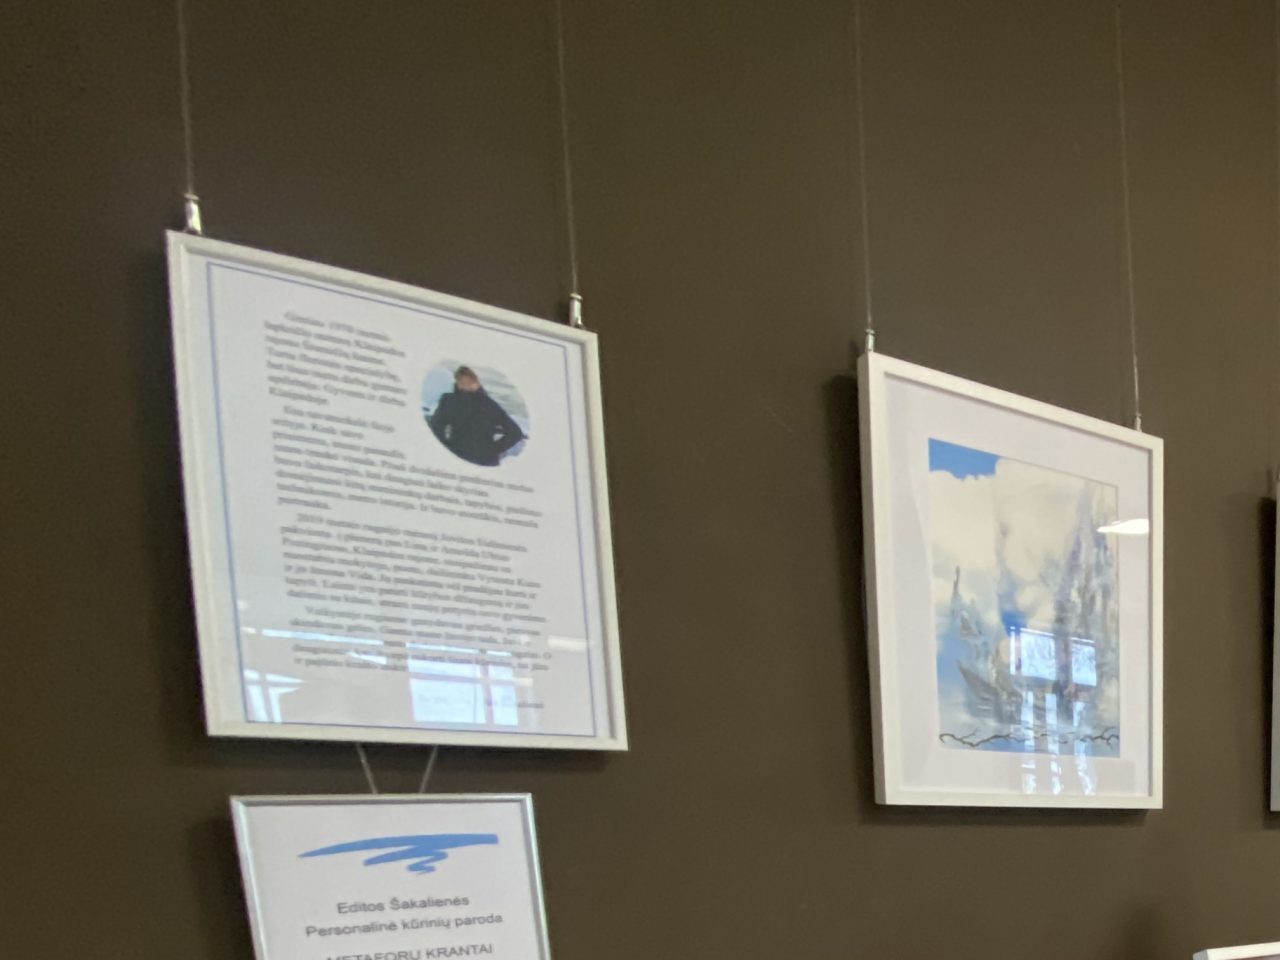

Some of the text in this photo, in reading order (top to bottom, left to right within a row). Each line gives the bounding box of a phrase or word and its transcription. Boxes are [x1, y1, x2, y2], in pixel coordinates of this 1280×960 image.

[337, 896, 470, 914] Editos Šakalienės
[306, 913, 503, 937] Personalinė kūrinių paroda
[426, 944, 493, 959] KRANTAI
